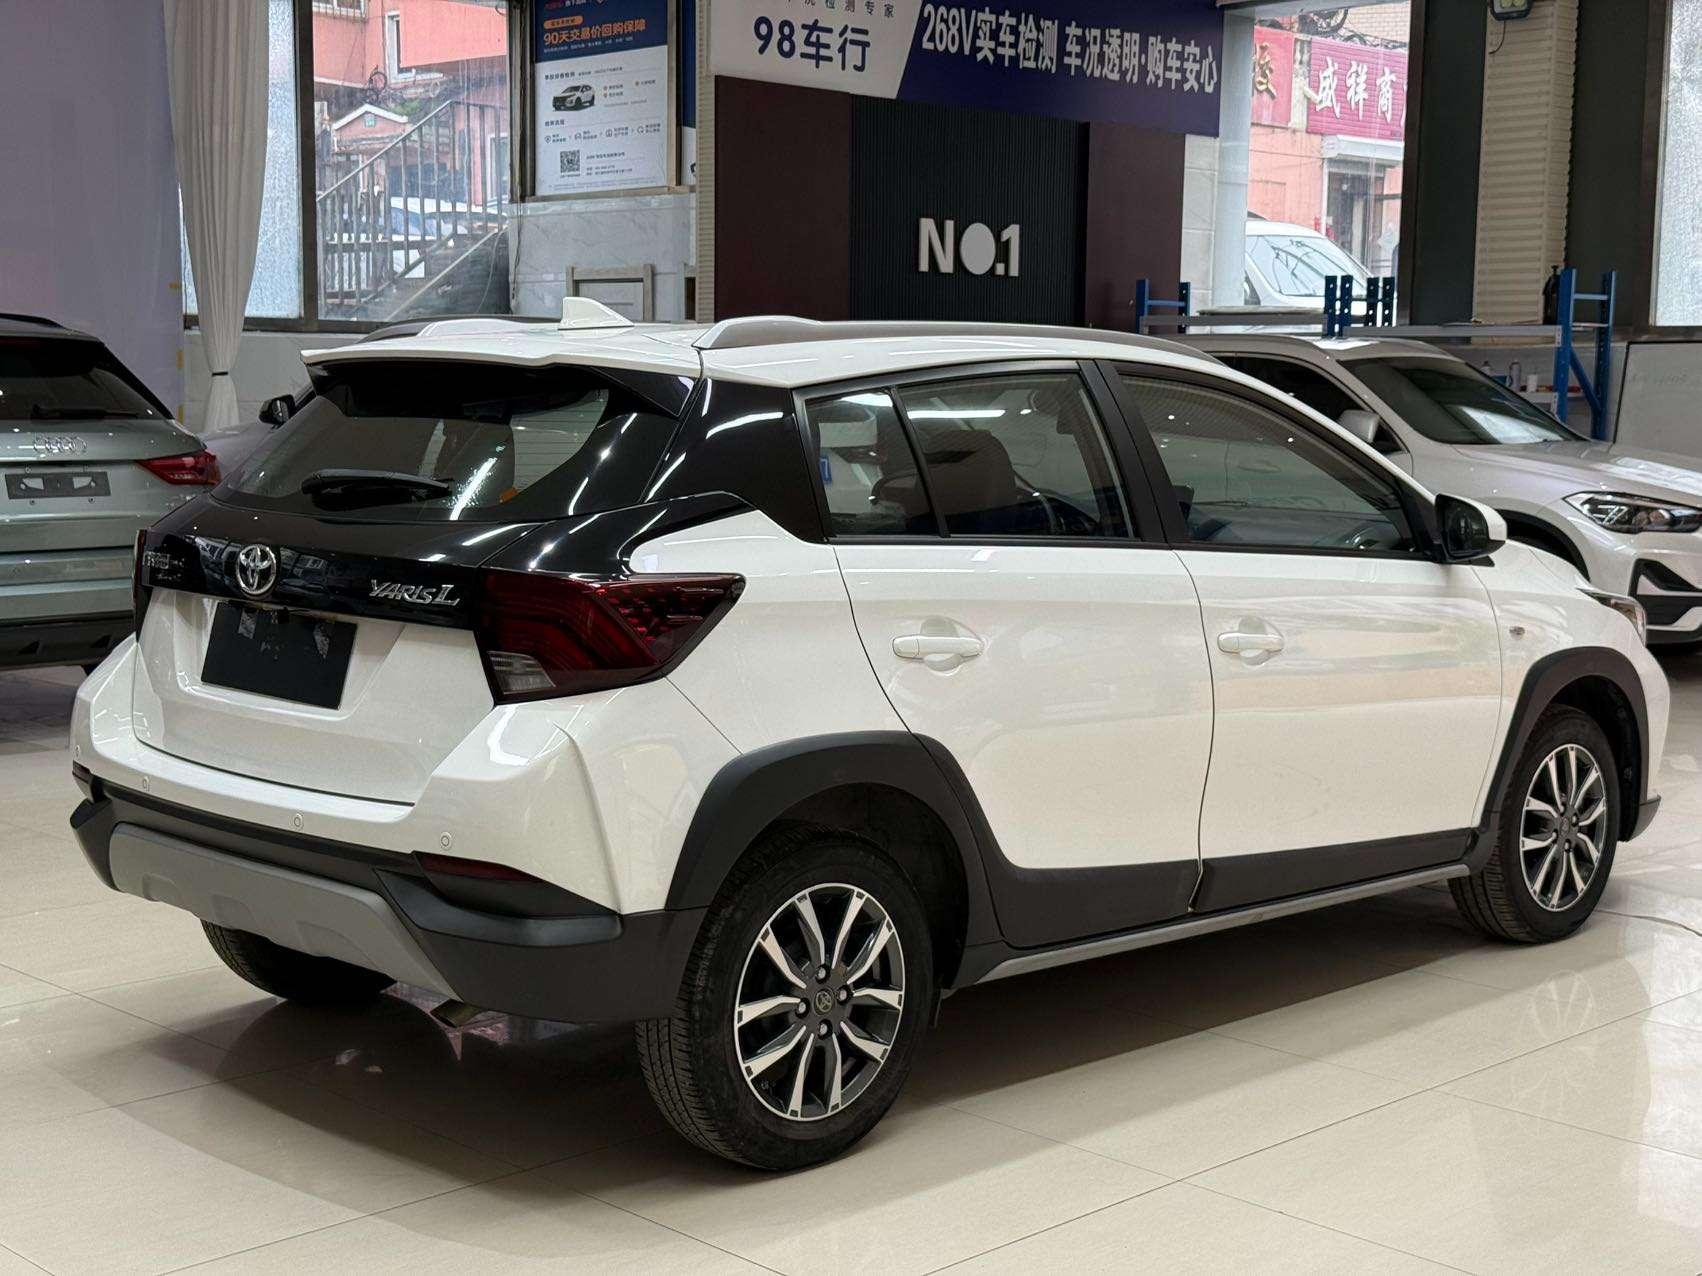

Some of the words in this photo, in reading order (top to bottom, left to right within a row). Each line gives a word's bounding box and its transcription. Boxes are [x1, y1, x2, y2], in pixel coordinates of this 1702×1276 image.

[753, 16, 871, 73] 98车行
[922, 3, 1058, 74] 268V实车检测
[1315, 56, 1408, 127] 盛祥商
[918, 217, 1020, 277] NO.1
[369, 579, 437, 605] YARIS
[432, 584, 460, 606] L
